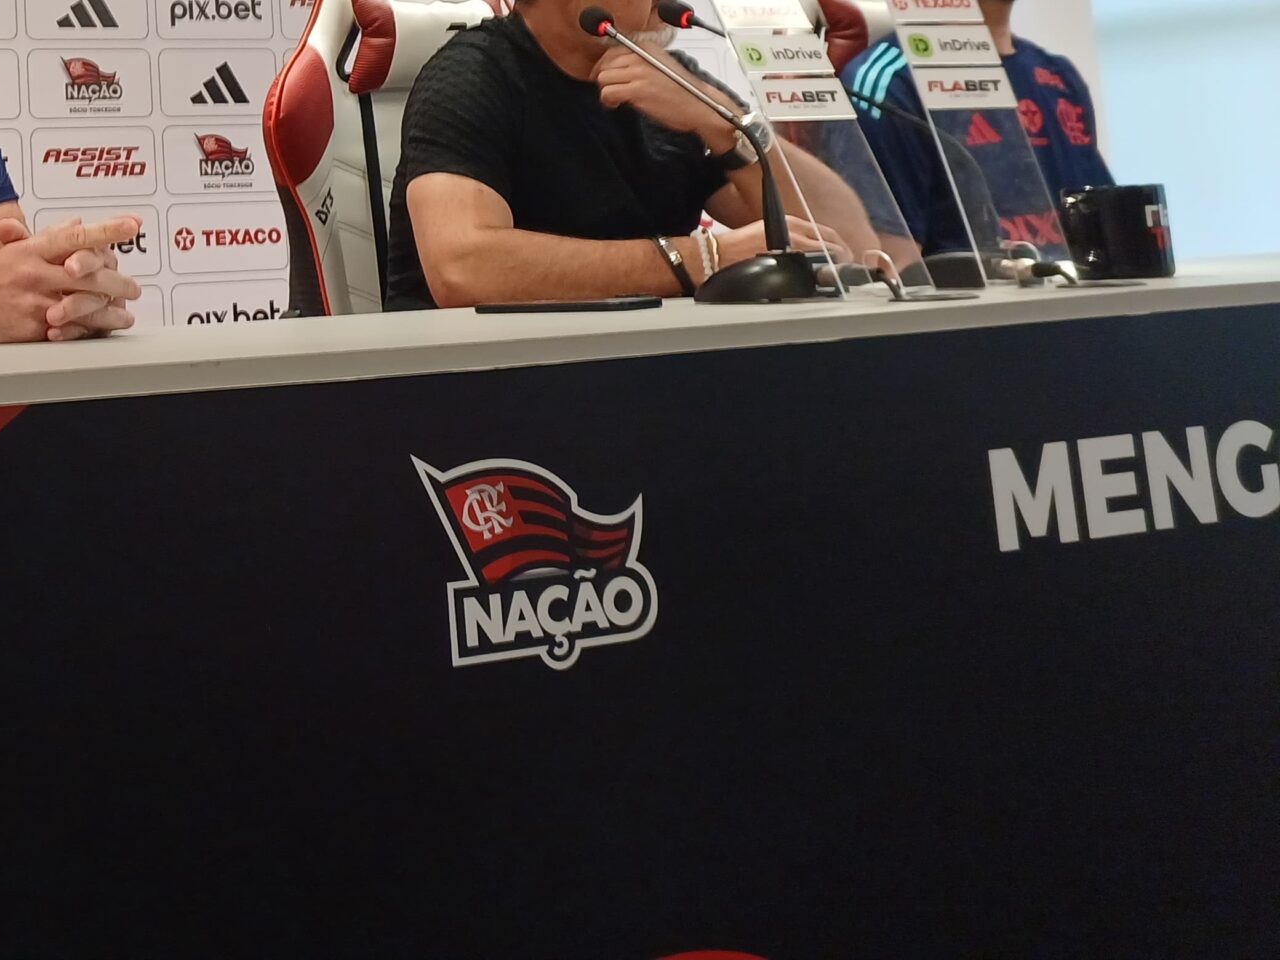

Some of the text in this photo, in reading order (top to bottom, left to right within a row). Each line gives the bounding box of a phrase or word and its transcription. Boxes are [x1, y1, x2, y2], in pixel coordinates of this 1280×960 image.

[939, 38, 990, 51] inDrive
[772, 47, 822, 60] inDrive
[927, 80, 1001, 92] FLABET
[766, 91, 837, 103] FLABET
[43, 147, 139, 162] ASSIST
[76, 161, 146, 177] CARD
[202, 227, 281, 246] TEXACO
[462, 569, 644, 657] NAÇÃO
